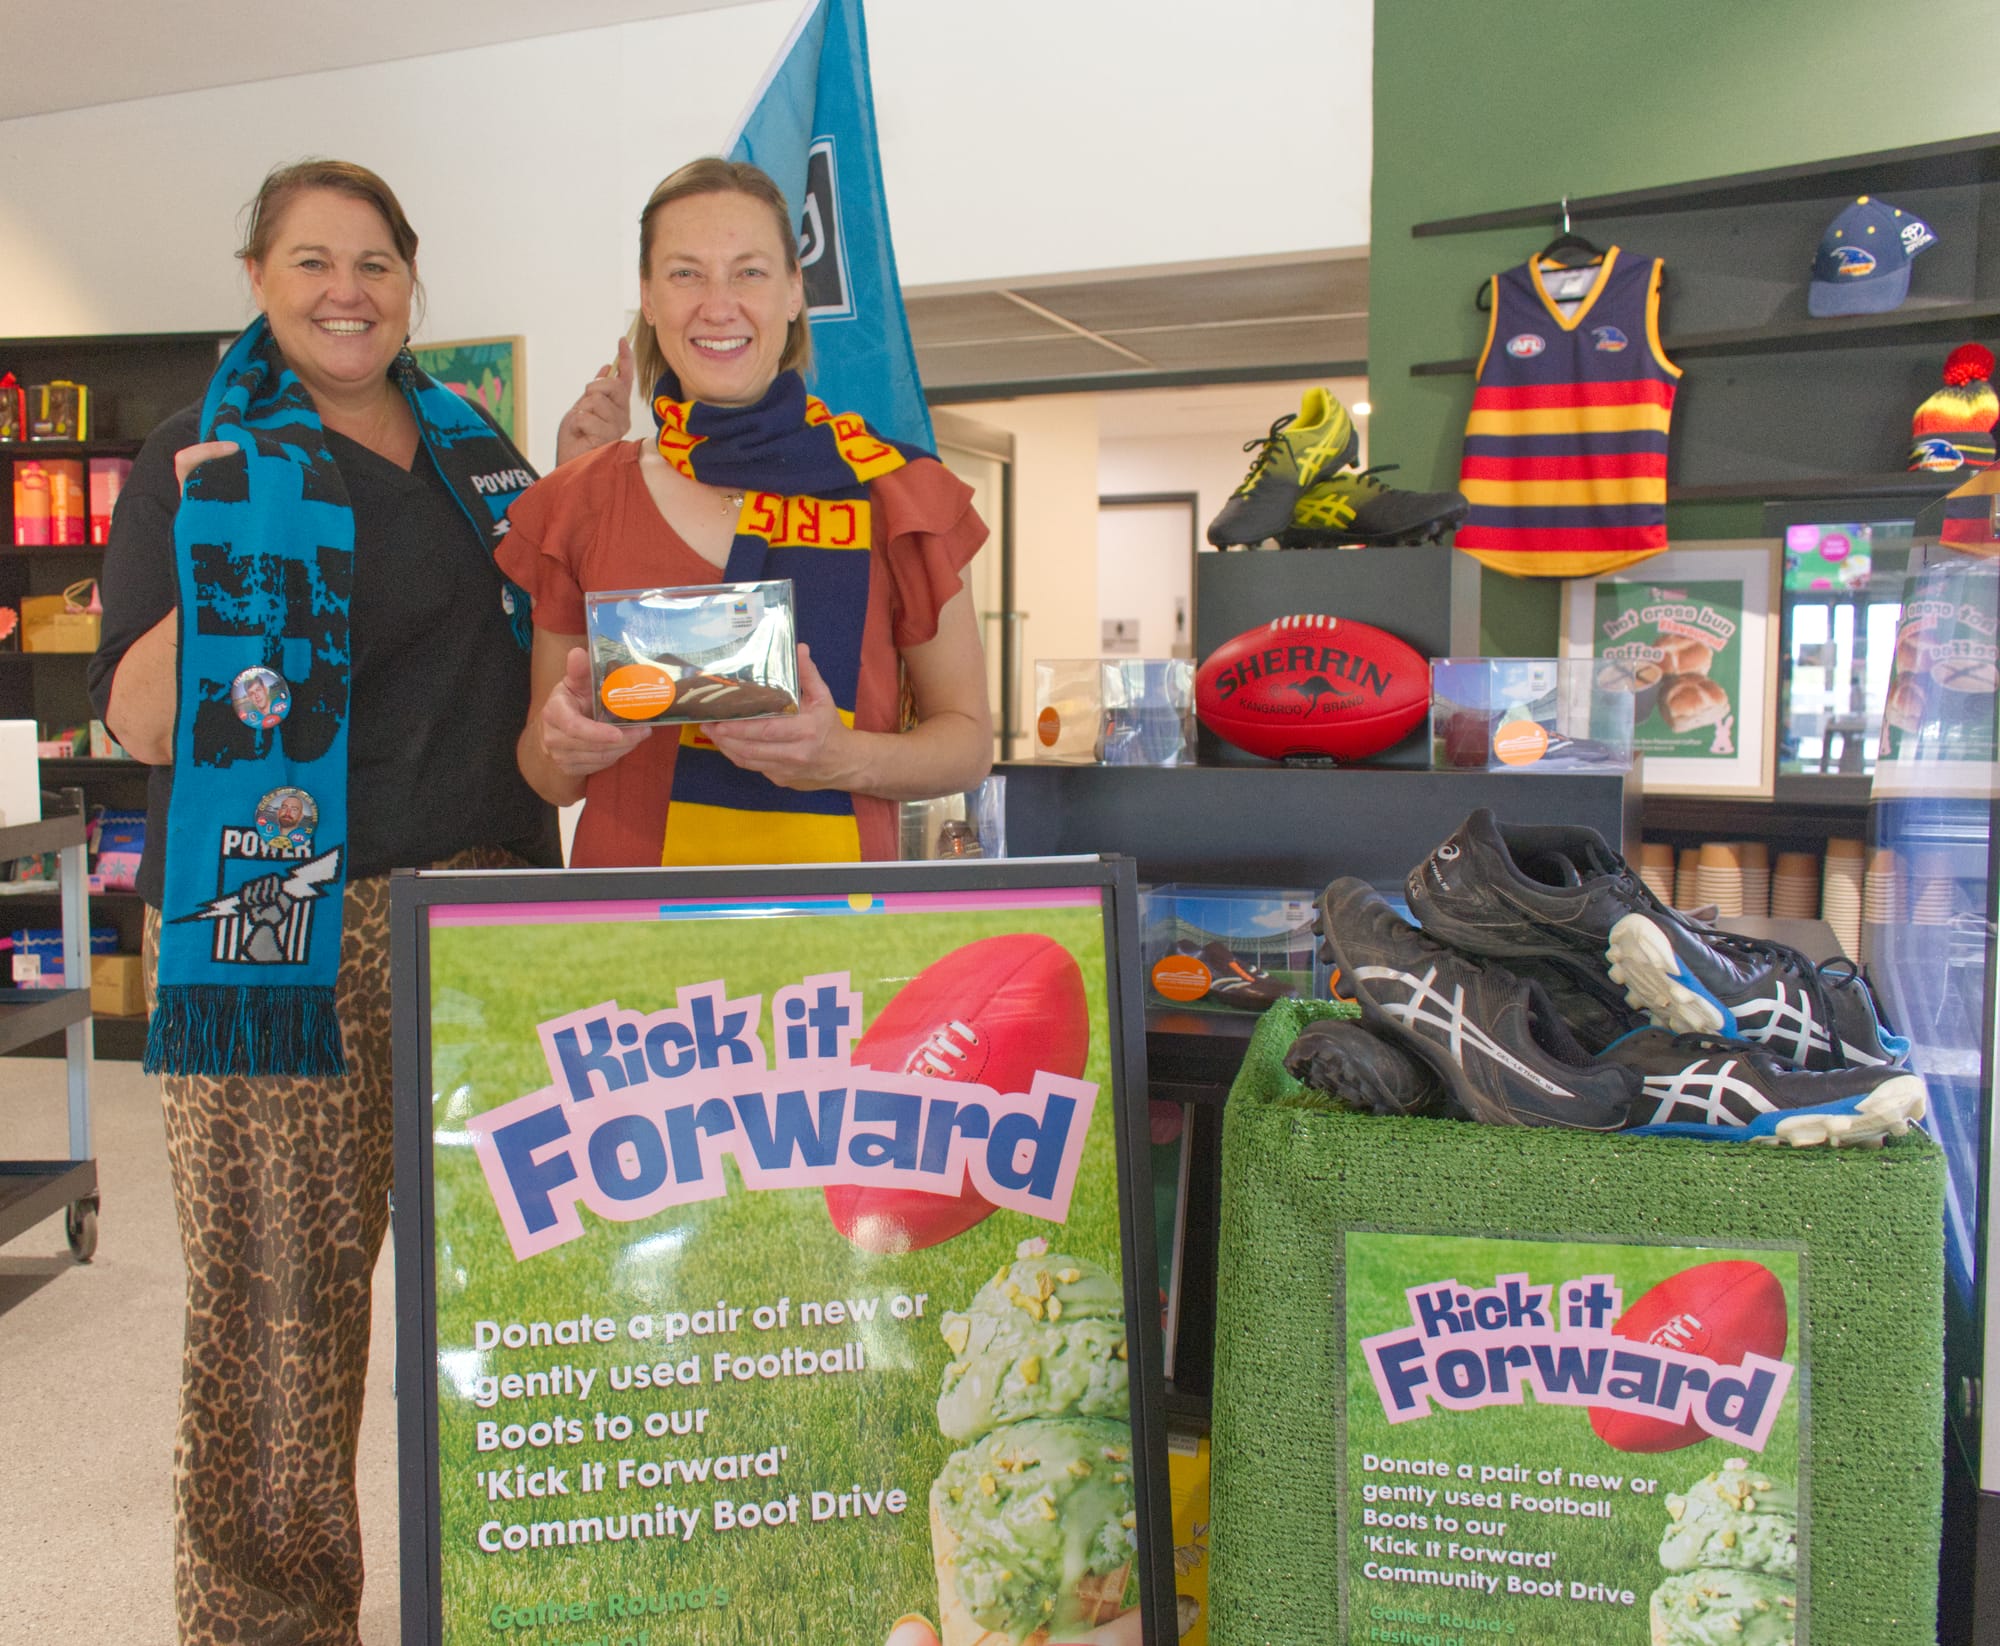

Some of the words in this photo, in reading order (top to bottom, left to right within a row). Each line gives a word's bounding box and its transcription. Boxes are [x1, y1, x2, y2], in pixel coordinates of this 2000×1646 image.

[1510, 337, 1542, 355] AFL
[749, 492, 856, 545] CRS
[1643, 607, 1696, 621] cross
[1702, 609, 1734, 635] bun
[1215, 646, 1393, 700] SHERRIN
[1239, 698, 1302, 715] KANGAROO
[1323, 696, 1364, 713] BRAND
[553, 994, 753, 1102] Kick
[785, 985, 850, 1060] it
[493, 1087, 1077, 1235] Forward
[474, 1313, 617, 1352] Donate
[628, 1315, 652, 1340] a
[666, 1300, 737, 1344] pair
[752, 1298, 790, 1332] of
[801, 1296, 880, 1326] new
[891, 1293, 929, 1320] or
[1416, 1281, 1545, 1338] Kick
[1567, 1282, 1613, 1329] it
[475, 1365, 597, 1409] gently
[609, 1354, 700, 1391] used
[713, 1342, 864, 1383] Football
[1376, 1336, 1776, 1437] Forward
[476, 1415, 584, 1452] Boots
[595, 1413, 632, 1442] to
[645, 1407, 710, 1438] our
[477, 1464, 569, 1502] 'Kick
[582, 1462, 606, 1493] It
[618, 1446, 789, 1492] Forward'
[1362, 1454, 1450, 1481] Donate
[1457, 1461, 1474, 1480] a
[1481, 1462, 1530, 1486] pair
[1537, 1467, 1563, 1487] of
[1569, 1471, 1622, 1491] new
[1630, 1476, 1658, 1495] or
[478, 1503, 700, 1554] Community
[714, 1495, 800, 1533] Boot
[811, 1485, 908, 1523] Drive
[1362, 1482, 1437, 1508] gently
[1444, 1487, 1502, 1510] used
[1510, 1493, 1612, 1519] Football
[1363, 1509, 1428, 1531] Boots
[1435, 1514, 1459, 1532] to
[1466, 1519, 1507, 1536] our
[1362, 1534, 1418, 1557] 'Kick
[1425, 1540, 1442, 1559] It
[1448, 1543, 1557, 1570] Forward'
[1363, 1561, 1500, 1593] Community
[1507, 1575, 1563, 1597] Boot
[1570, 1582, 1636, 1605] Drive
[490, 1599, 600, 1631] Gather
[607, 1584, 729, 1617] Round's
[1370, 1605, 1435, 1625] Gather
[1439, 1612, 1515, 1634] Round's
[1370, 1627, 1440, 1646] Festival
